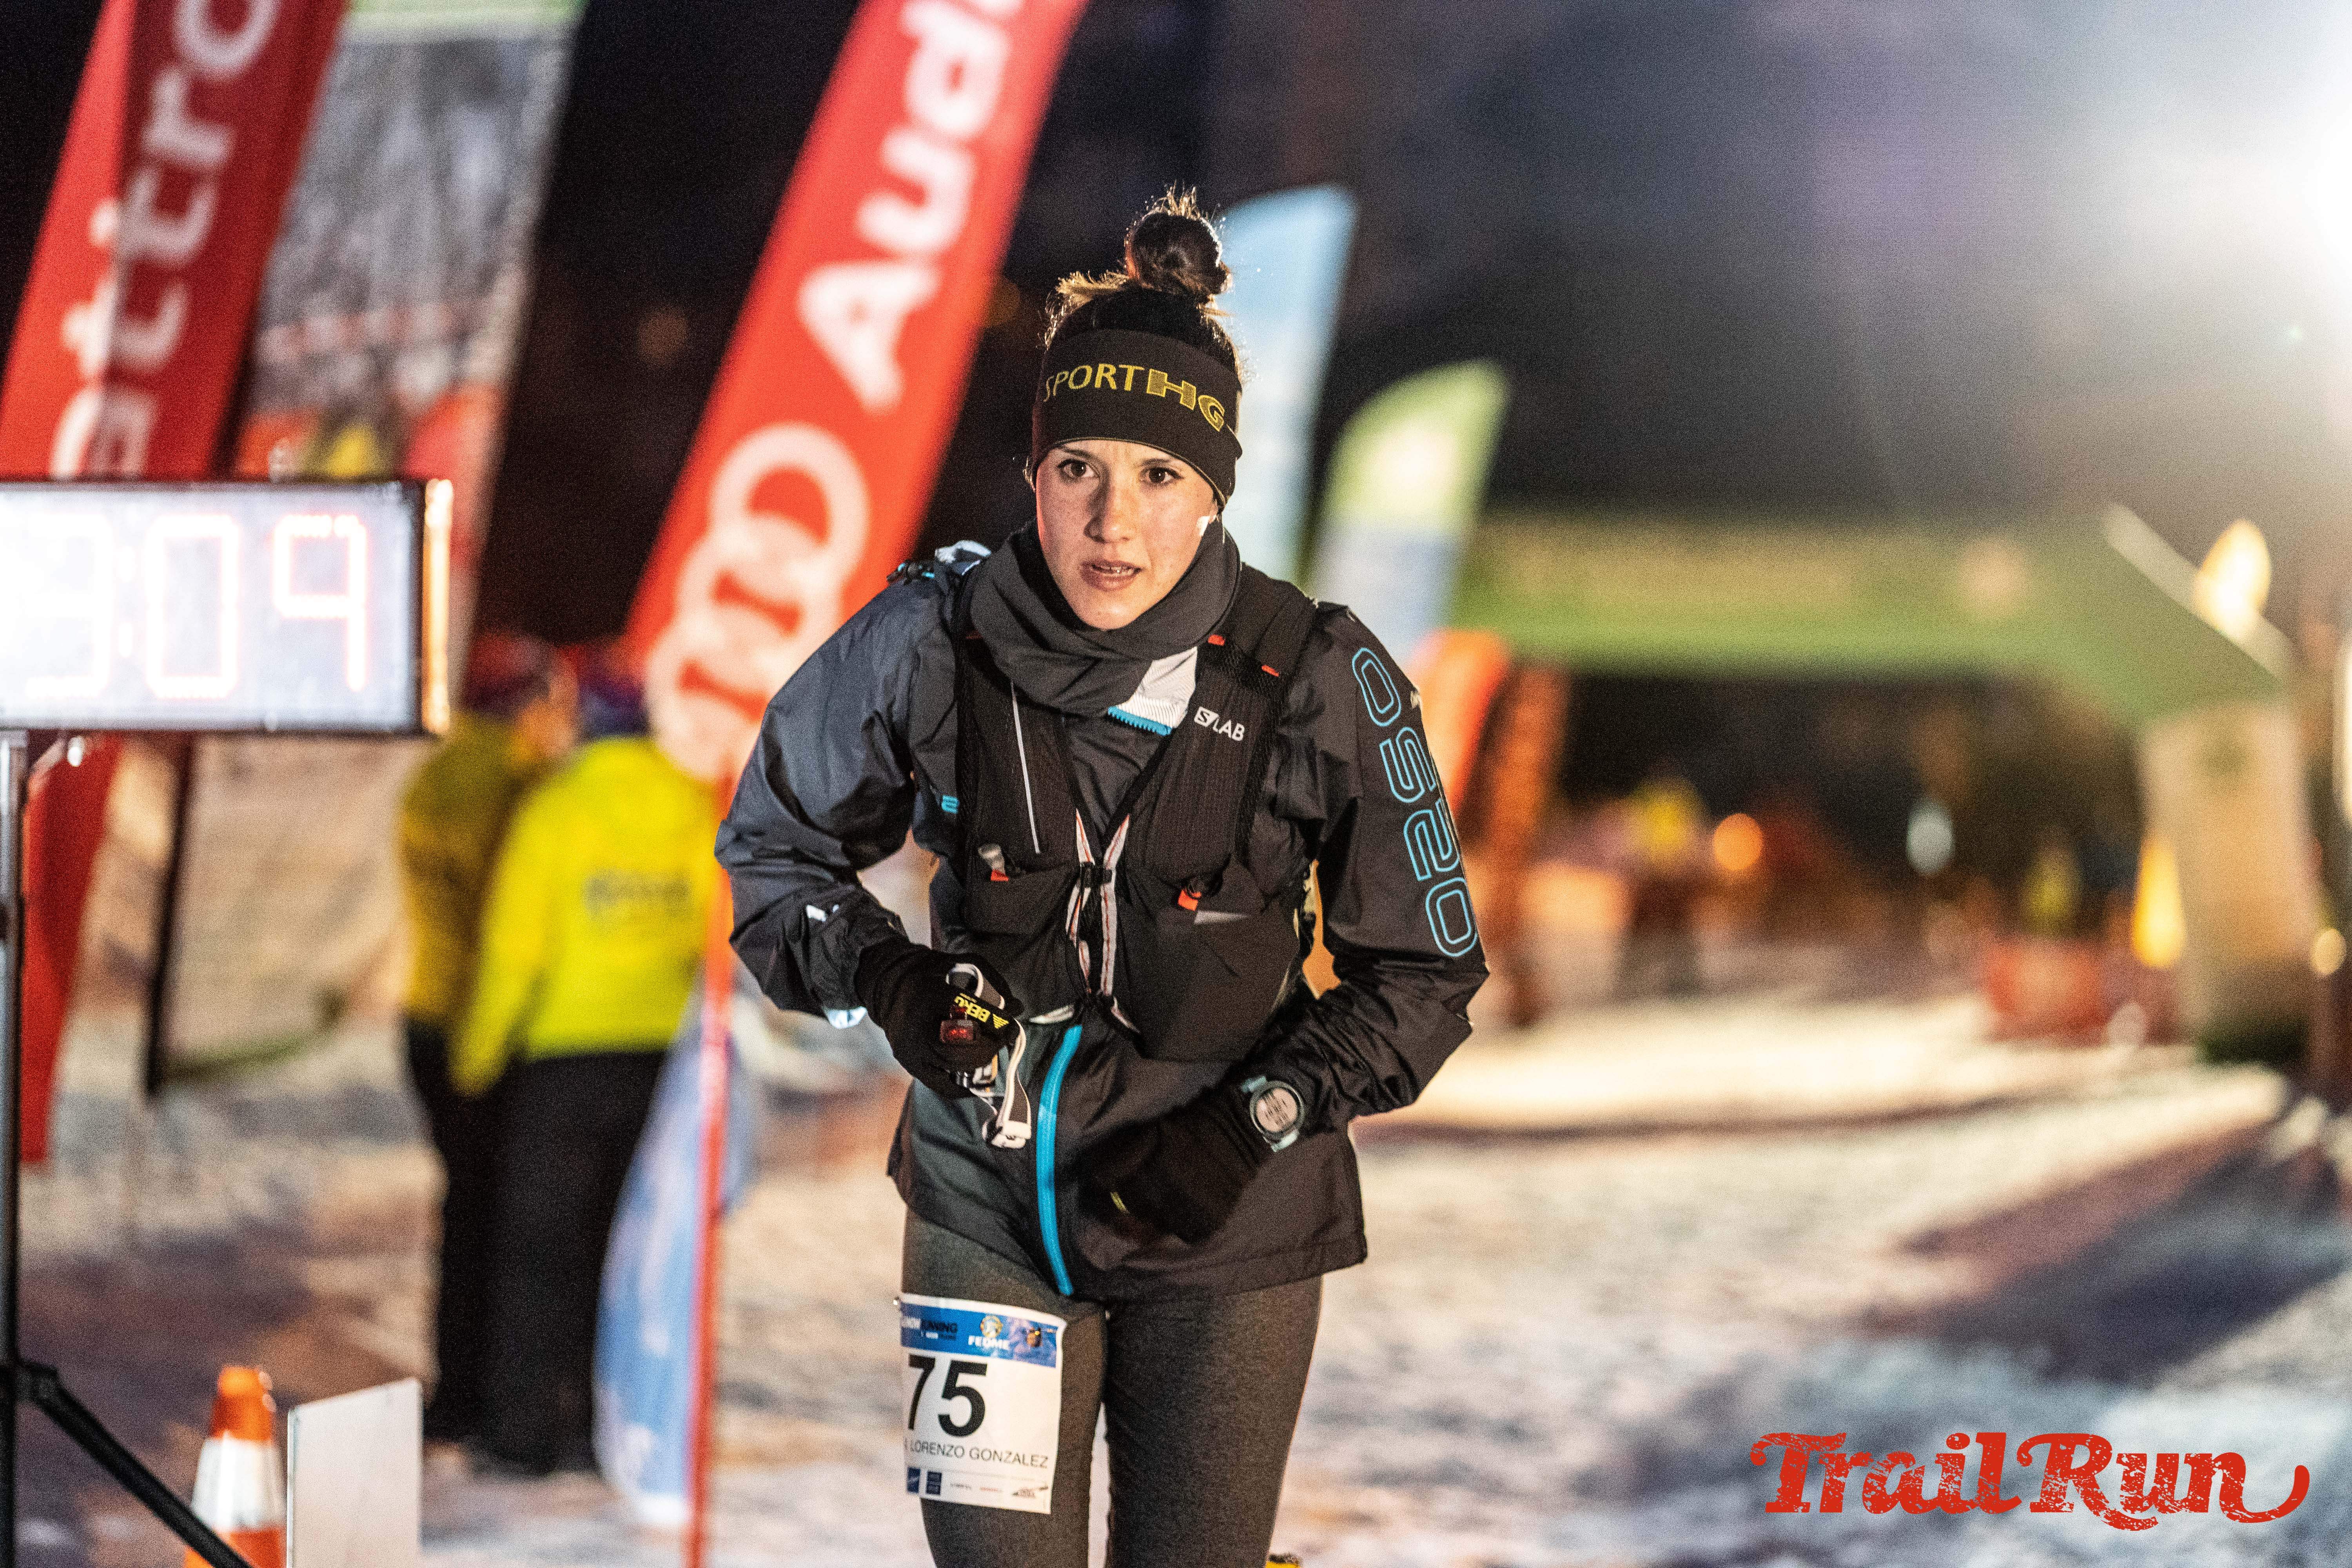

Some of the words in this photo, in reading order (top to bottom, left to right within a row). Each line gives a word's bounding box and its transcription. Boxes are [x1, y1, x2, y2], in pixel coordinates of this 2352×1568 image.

[797, 0, 1021, 412] Aud
[908, 1354, 988, 1438] 75
[910, 1439, 965, 1459] LORENZO
[969, 1446, 1049, 1469] GONZALEZ
